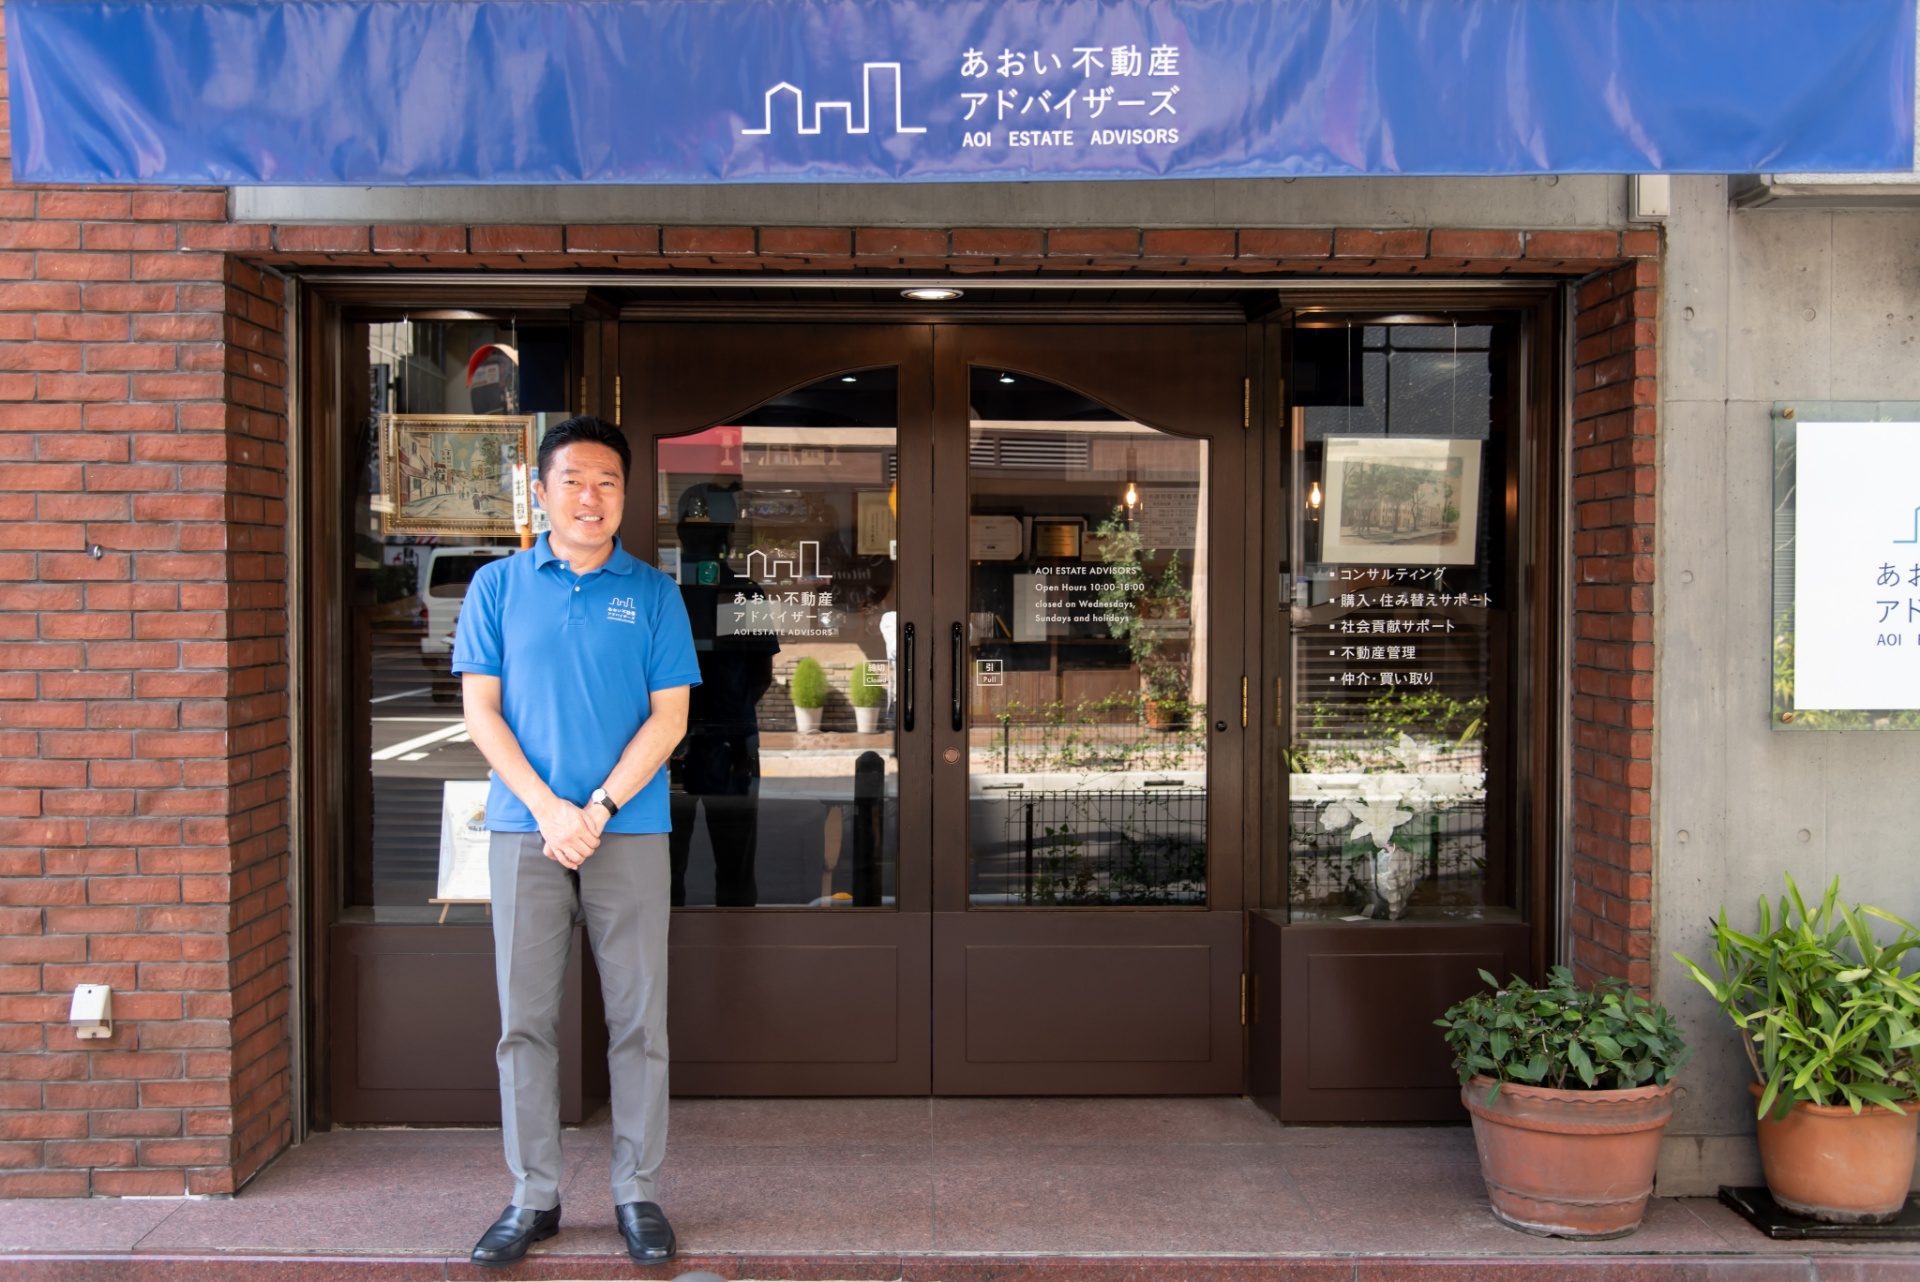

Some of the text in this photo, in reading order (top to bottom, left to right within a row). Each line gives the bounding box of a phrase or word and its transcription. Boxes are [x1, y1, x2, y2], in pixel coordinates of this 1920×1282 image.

[960, 44, 1180, 78] あおい不動産
[960, 85, 1180, 120] アドバイザーズ
[962, 128, 1179, 147] AOI ESTATE ADVISORS
[1035, 566, 1137, 575] AOI ESTATE ADVISORS
[1340, 566, 1447, 581] コンサルティング
[1035, 583, 1145, 593] Open Hours 10:00-18:00
[733, 591, 833, 607] あおい不動産
[1035, 600, 1063, 608] closed
[1078, 600, 1136, 609] Wednesdays,
[1340, 592, 1493, 608] 購入・住み替えサポート
[733, 610, 833, 623] アドバイザーズ
[1035, 614, 1129, 624] Sundays and holidays
[733, 628, 833, 636] AOI ESTATE ADVISORS
[1340, 618, 1455, 634] 社会貢献サポート
[1876, 633, 1902, 646] AOI
[1340, 645, 1417, 660] 不動産管理
[983, 675, 997, 683] Pull
[1340, 671, 1434, 686] 仲介・買い取り
